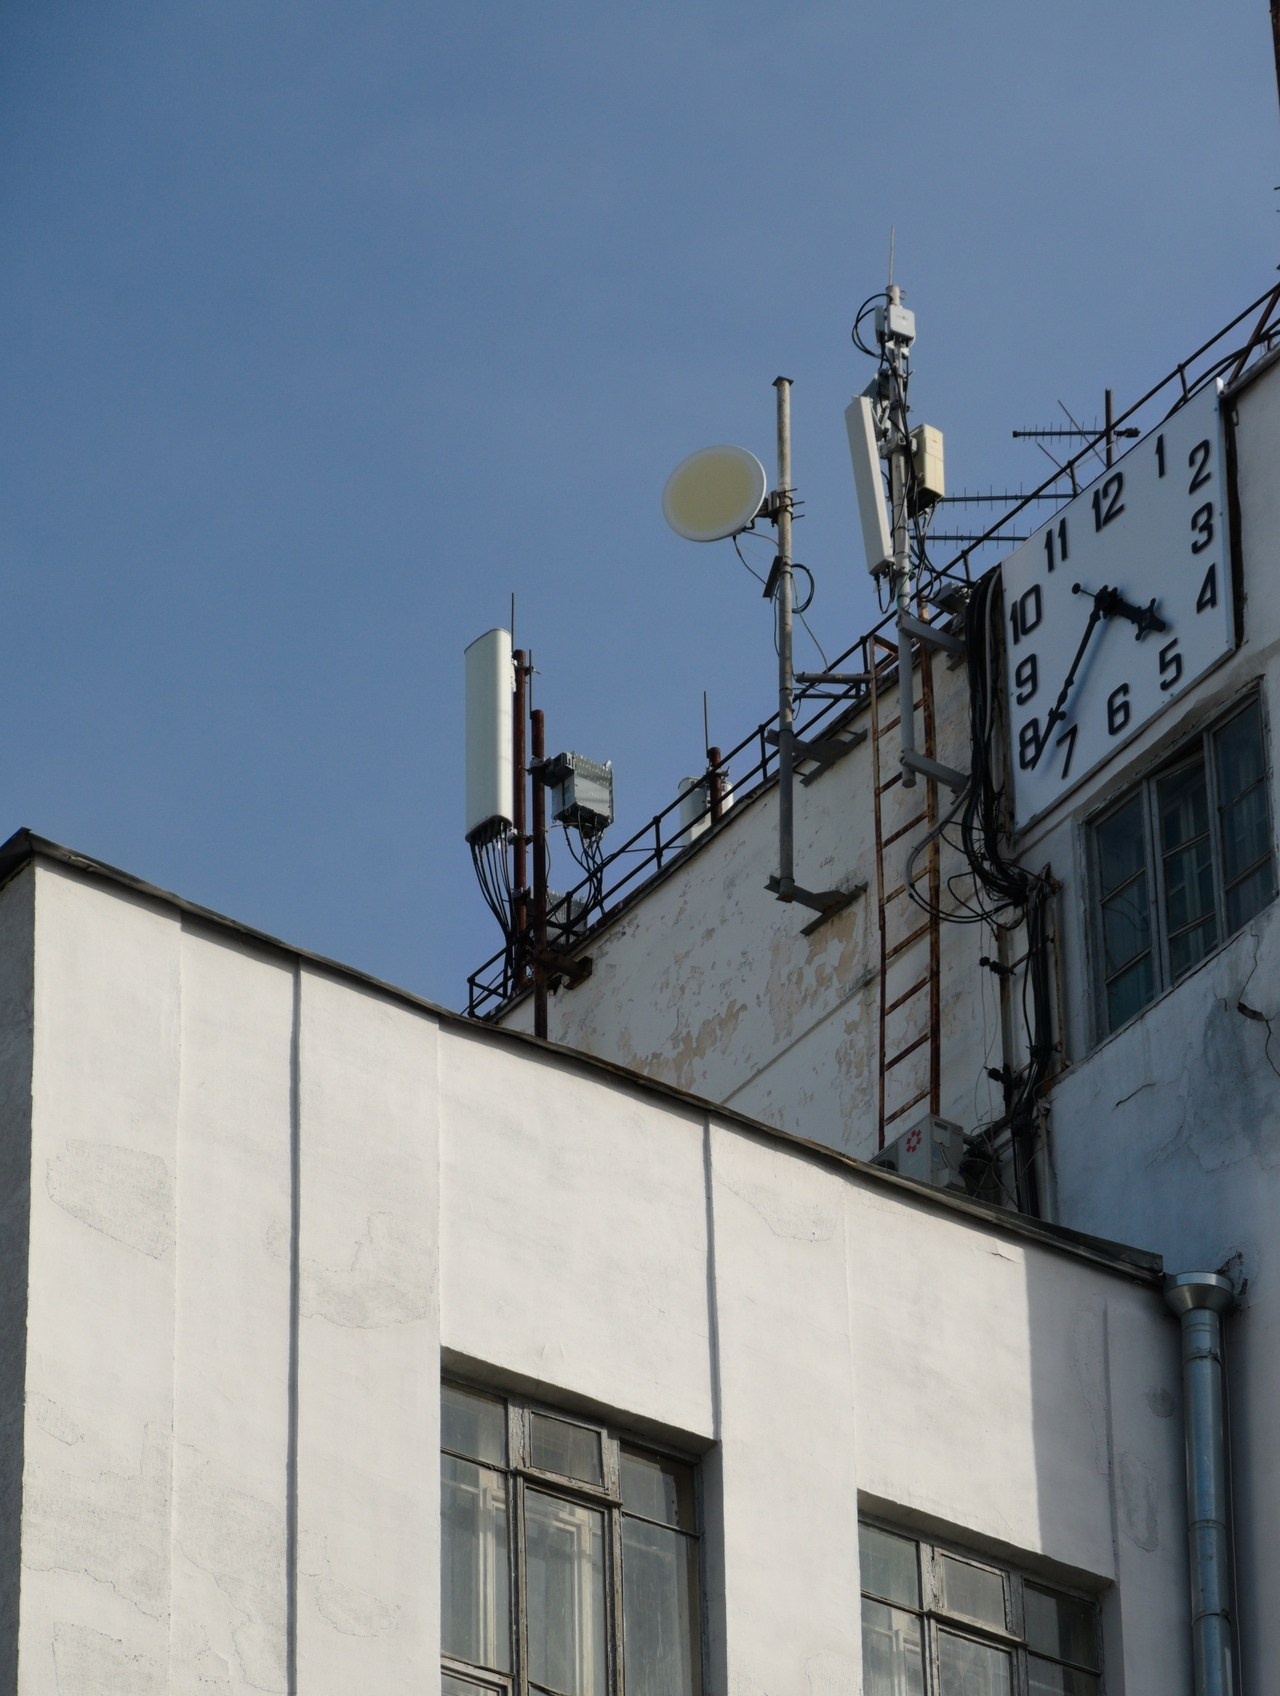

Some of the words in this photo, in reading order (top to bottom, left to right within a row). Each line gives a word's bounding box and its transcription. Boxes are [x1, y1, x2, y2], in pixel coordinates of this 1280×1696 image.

[1155, 434, 1165, 478] 1
[1188, 440, 1210, 494] 2
[1092, 472, 1124, 532] 12
[1191, 502, 1213, 554] 3
[1045, 518, 1067, 572] 11
[1010, 584, 1041, 644] 10
[1197, 563, 1216, 613] 4
[1016, 654, 1037, 705] 9
[1159, 638, 1182, 691] 5
[1107, 683, 1129, 735] 6
[1019, 718, 1040, 770] 8
[1057, 725, 1077, 779] 7
